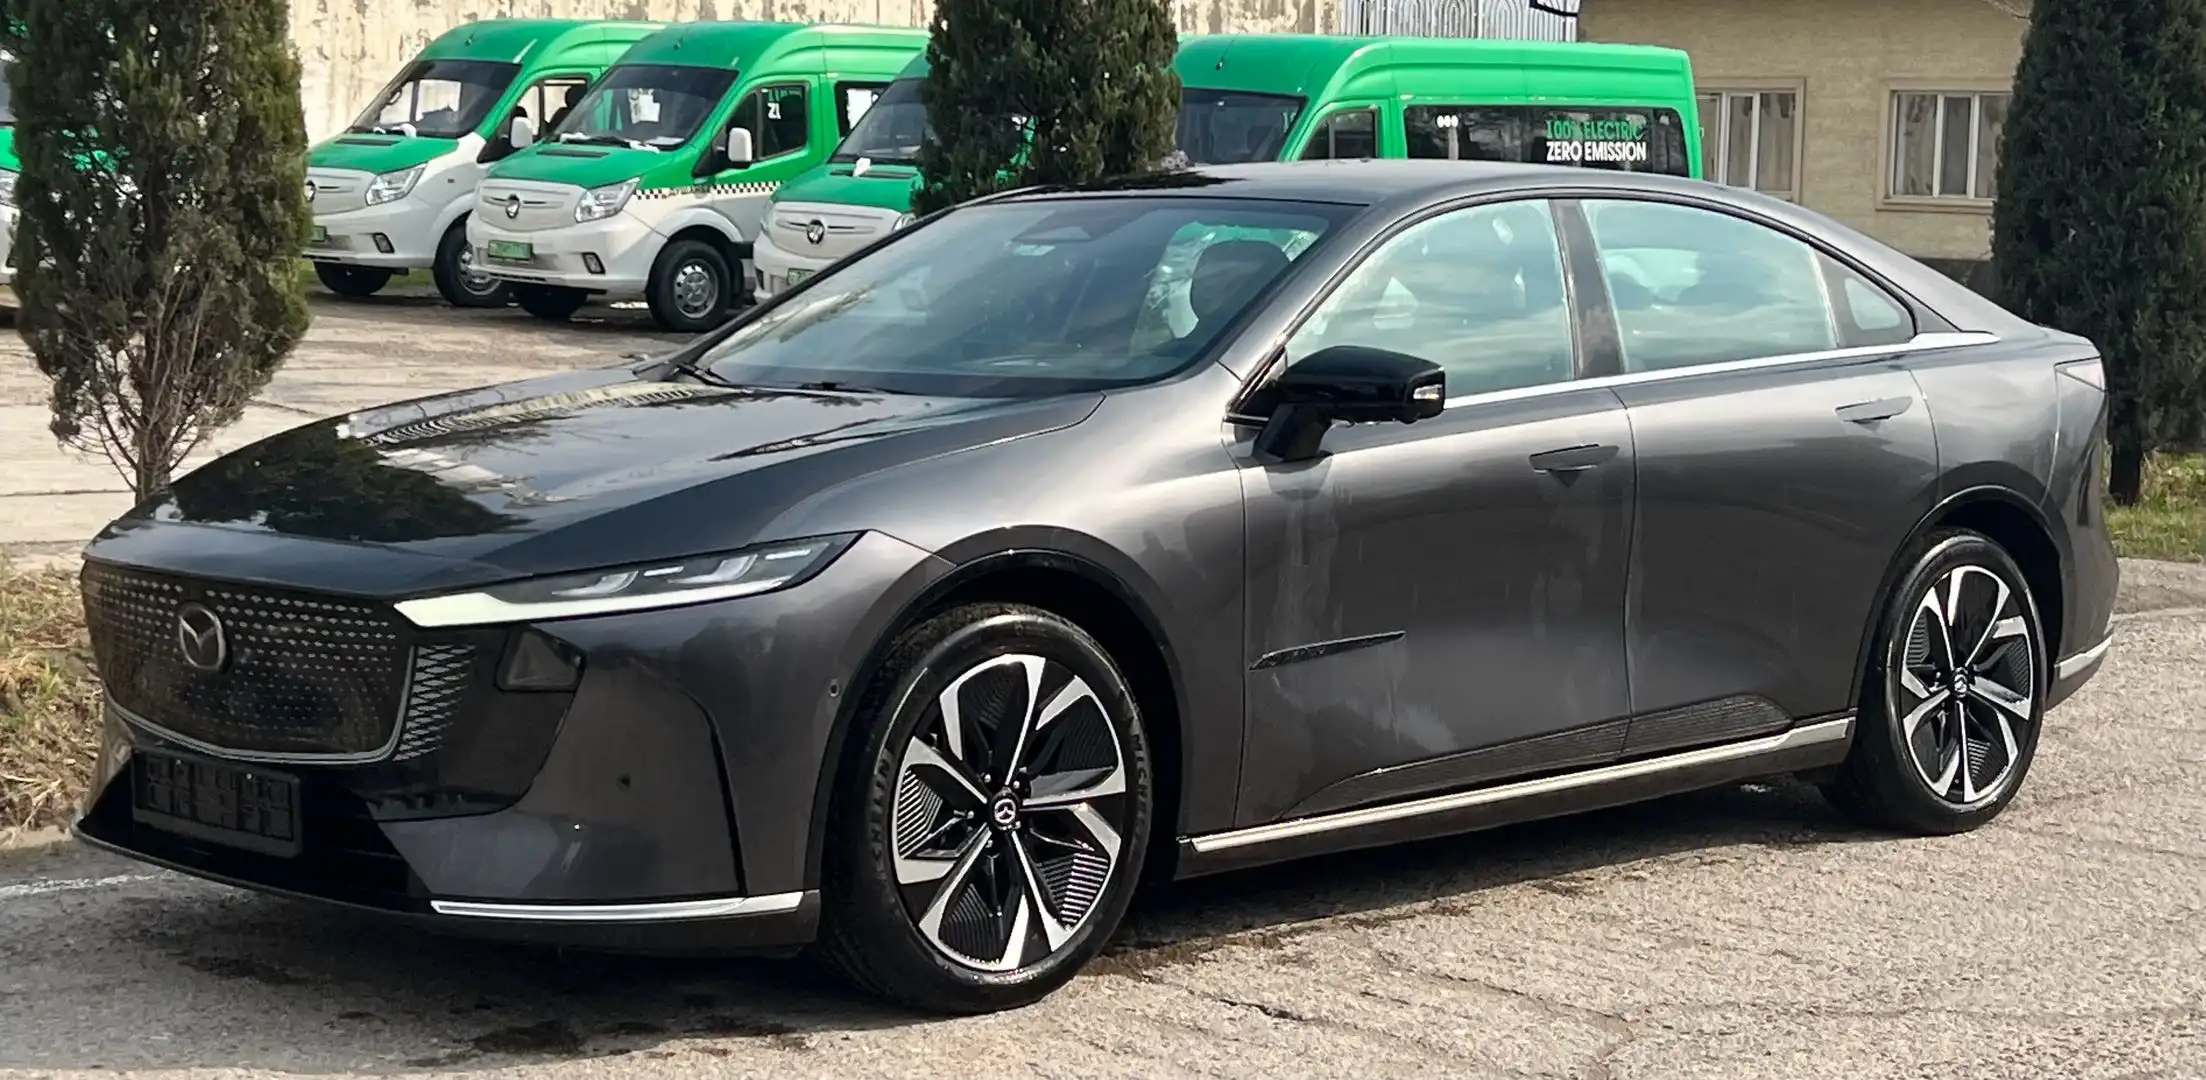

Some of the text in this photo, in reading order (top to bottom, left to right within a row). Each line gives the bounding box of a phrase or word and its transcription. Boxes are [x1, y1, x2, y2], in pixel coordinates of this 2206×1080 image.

[1584, 119, 1646, 141] ELECTRIC
[1546, 141, 1647, 161] ZERO EMISSION
